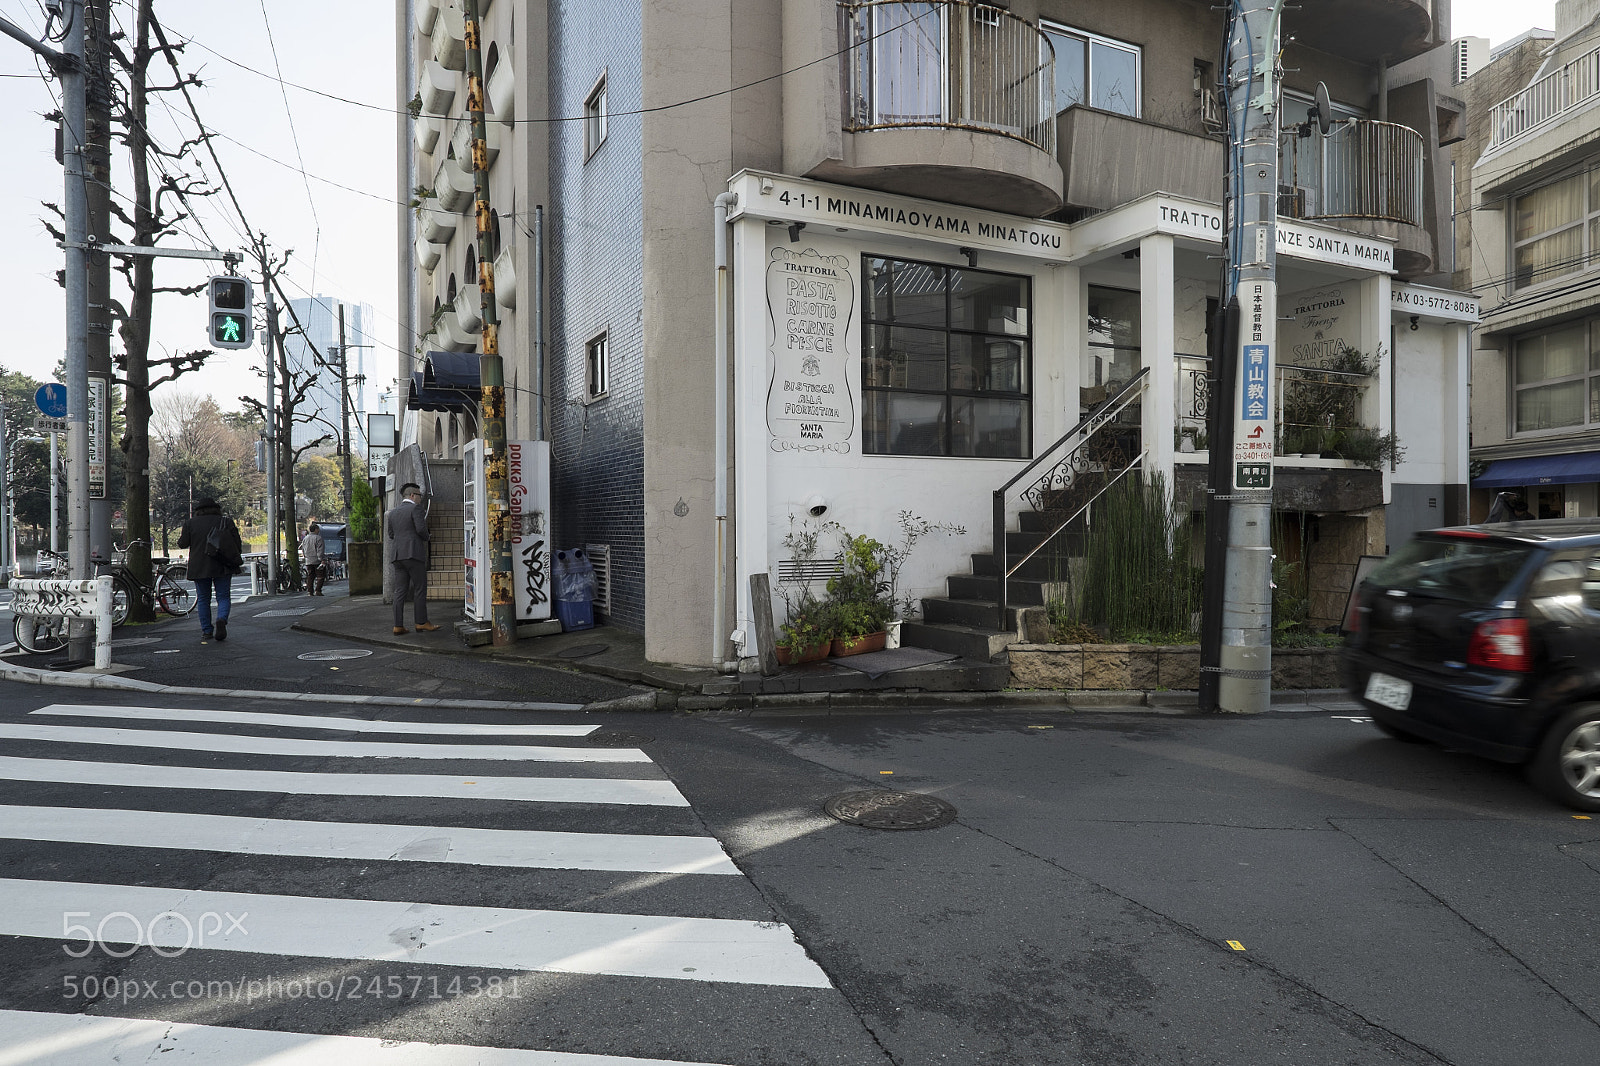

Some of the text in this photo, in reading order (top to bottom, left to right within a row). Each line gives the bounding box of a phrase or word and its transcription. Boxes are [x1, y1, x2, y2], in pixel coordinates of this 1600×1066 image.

[779, 190, 1062, 249] 4-1-1 MINAMIAOYAMA MINATOKU
[1308, 235, 1350, 256] SANTA
[1354, 244, 1391, 264] MARIA
[784, 262, 837, 277] TRATTORIA
[786, 277, 837, 302] PASTA
[785, 298, 837, 320] RISOTTO
[1293, 298, 1346, 315] TRATTORIA
[1391, 290, 1475, 314] FAX 03-5772-8085
[1252, 285, 1263, 342] 日本基督教団
[786, 318, 835, 337] CARNE
[786, 334, 834, 354] PESCE
[1292, 337, 1347, 363] SANTA
[783, 380, 835, 395] BISTECCA
[1247, 348, 1265, 417] 青山教会
[797, 394, 823, 405] ALLA
[784, 402, 840, 418] FIORENTINA
[800, 423, 824, 432] SANTA
[800, 431, 824, 439] MARIA
[1246, 477, 1264, 485] 4-1
